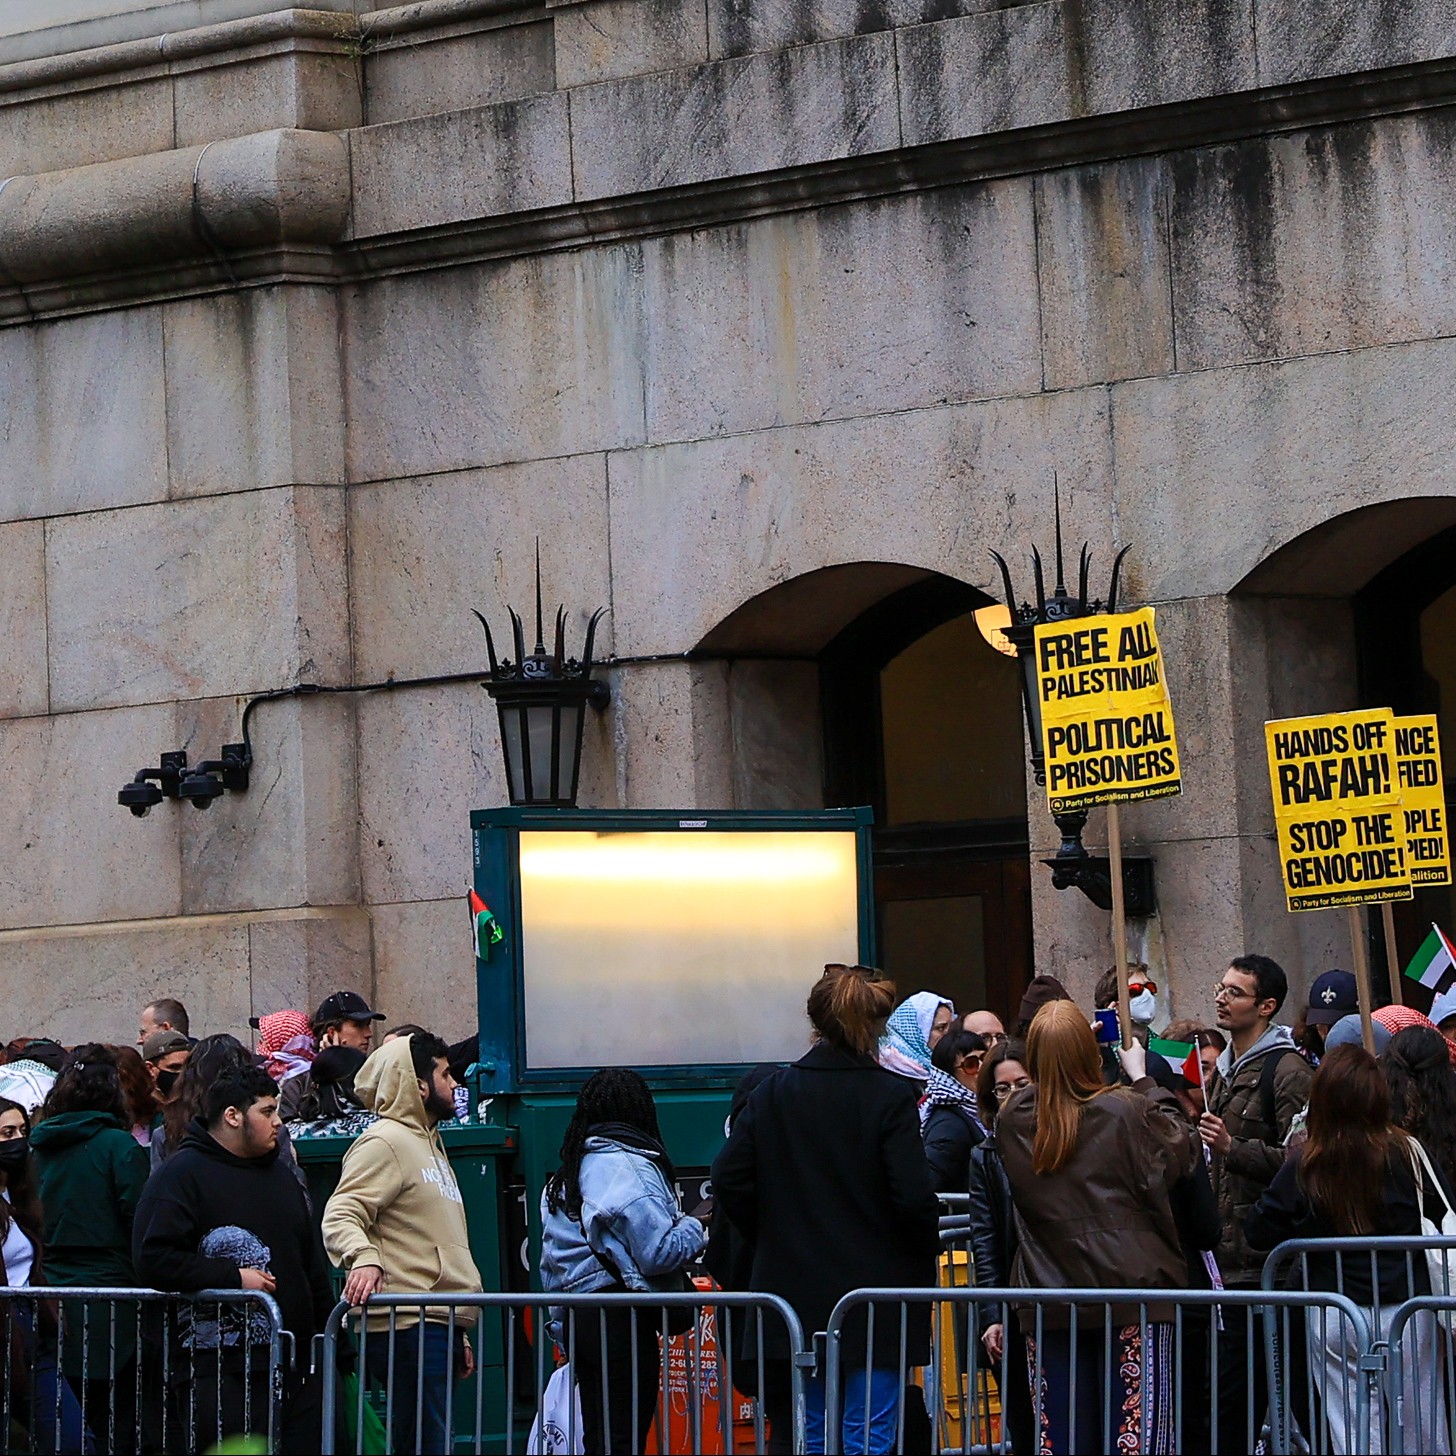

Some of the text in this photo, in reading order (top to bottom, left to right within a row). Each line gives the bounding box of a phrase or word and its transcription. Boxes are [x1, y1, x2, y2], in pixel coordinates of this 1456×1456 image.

[1039, 621, 1157, 672] FREE ALL
[1047, 711, 1171, 759] POLITICAL
[1274, 720, 1387, 760] HANDS OFF
[1050, 747, 1175, 791] PRISONERS
[1278, 753, 1391, 806] RAFAH!
[1065, 799, 1083, 808] Party
[1084, 796, 1094, 805] for
[1095, 791, 1129, 803] Socialism
[1130, 790, 1144, 799] and
[1145, 784, 1180, 797] Liberation
[1289, 813, 1395, 853] STOP THE
[1286, 847, 1406, 889] GENOCIDE!
[1302, 899, 1319, 908] Party
[1331, 894, 1363, 905] Socialism
[1378, 889, 1411, 900] Liberation
